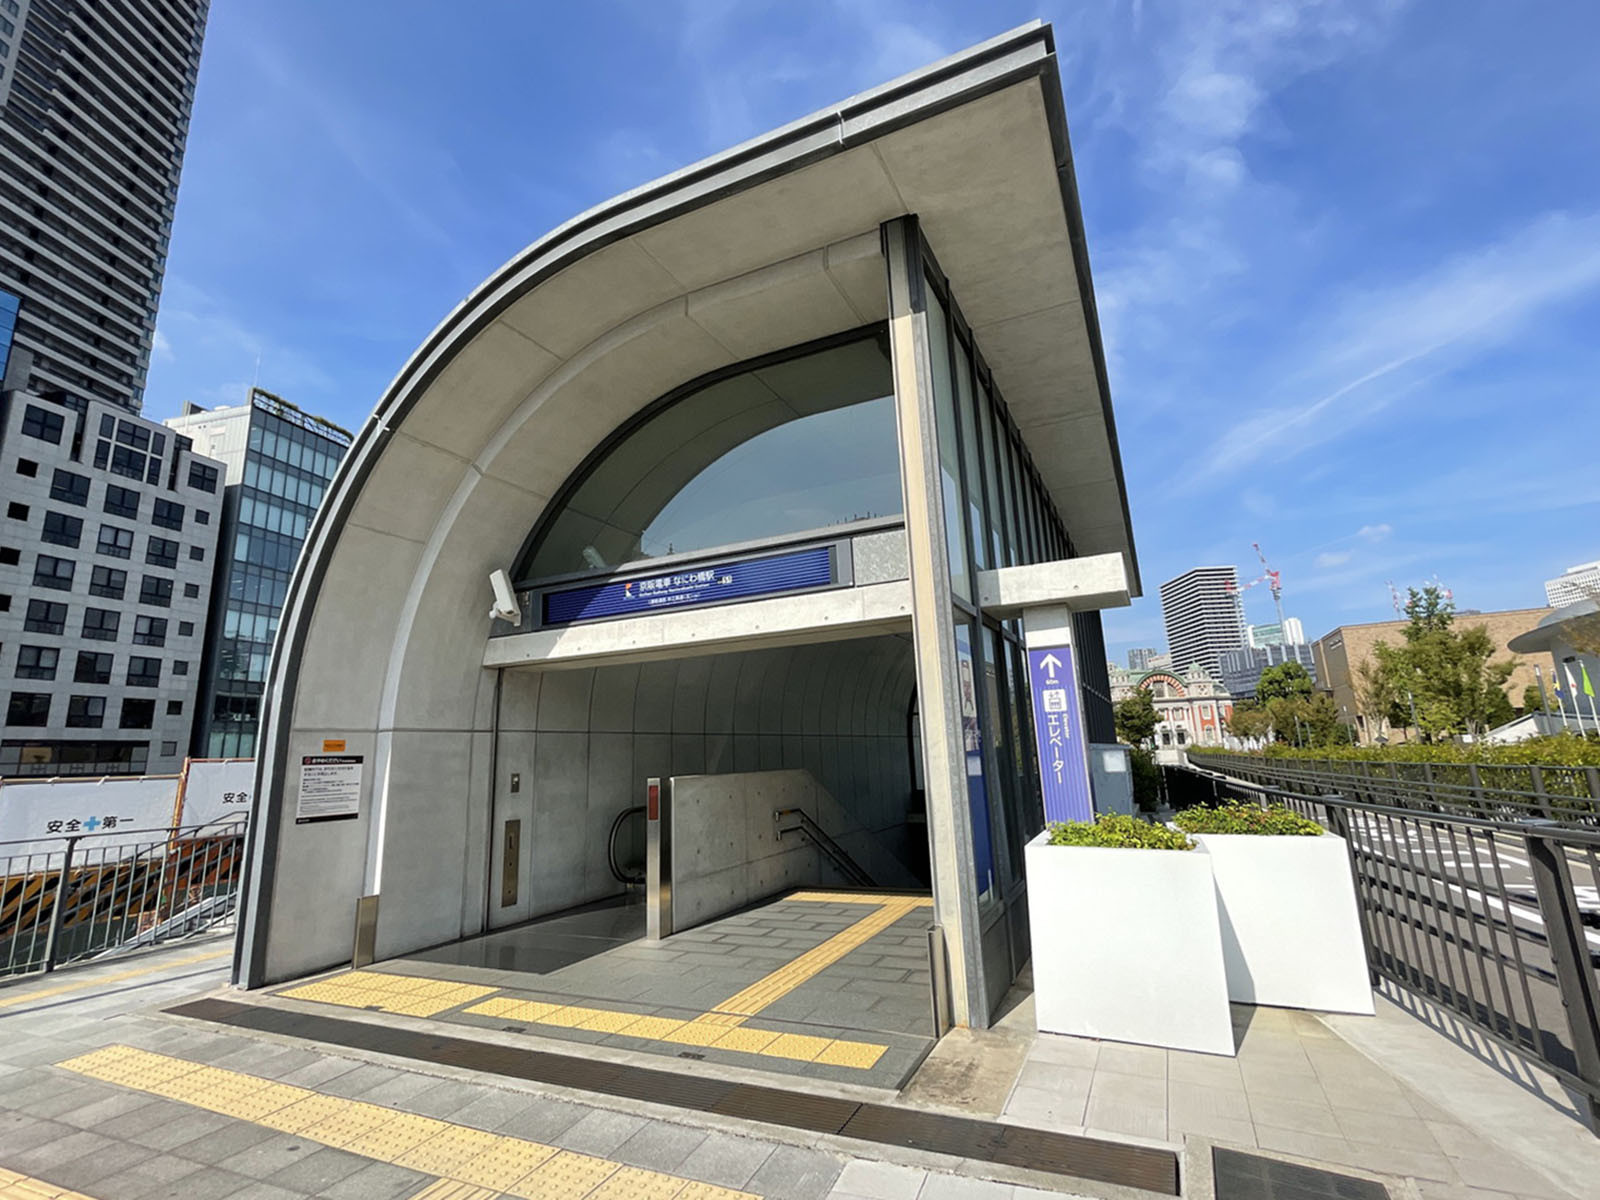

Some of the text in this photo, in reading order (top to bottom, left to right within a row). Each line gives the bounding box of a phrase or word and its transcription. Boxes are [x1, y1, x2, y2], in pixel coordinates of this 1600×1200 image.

[673, 570, 715, 586] なにわ橋駅
[1047, 714, 1064, 784] エレベーター
[222, 791, 248, 804] 安全
